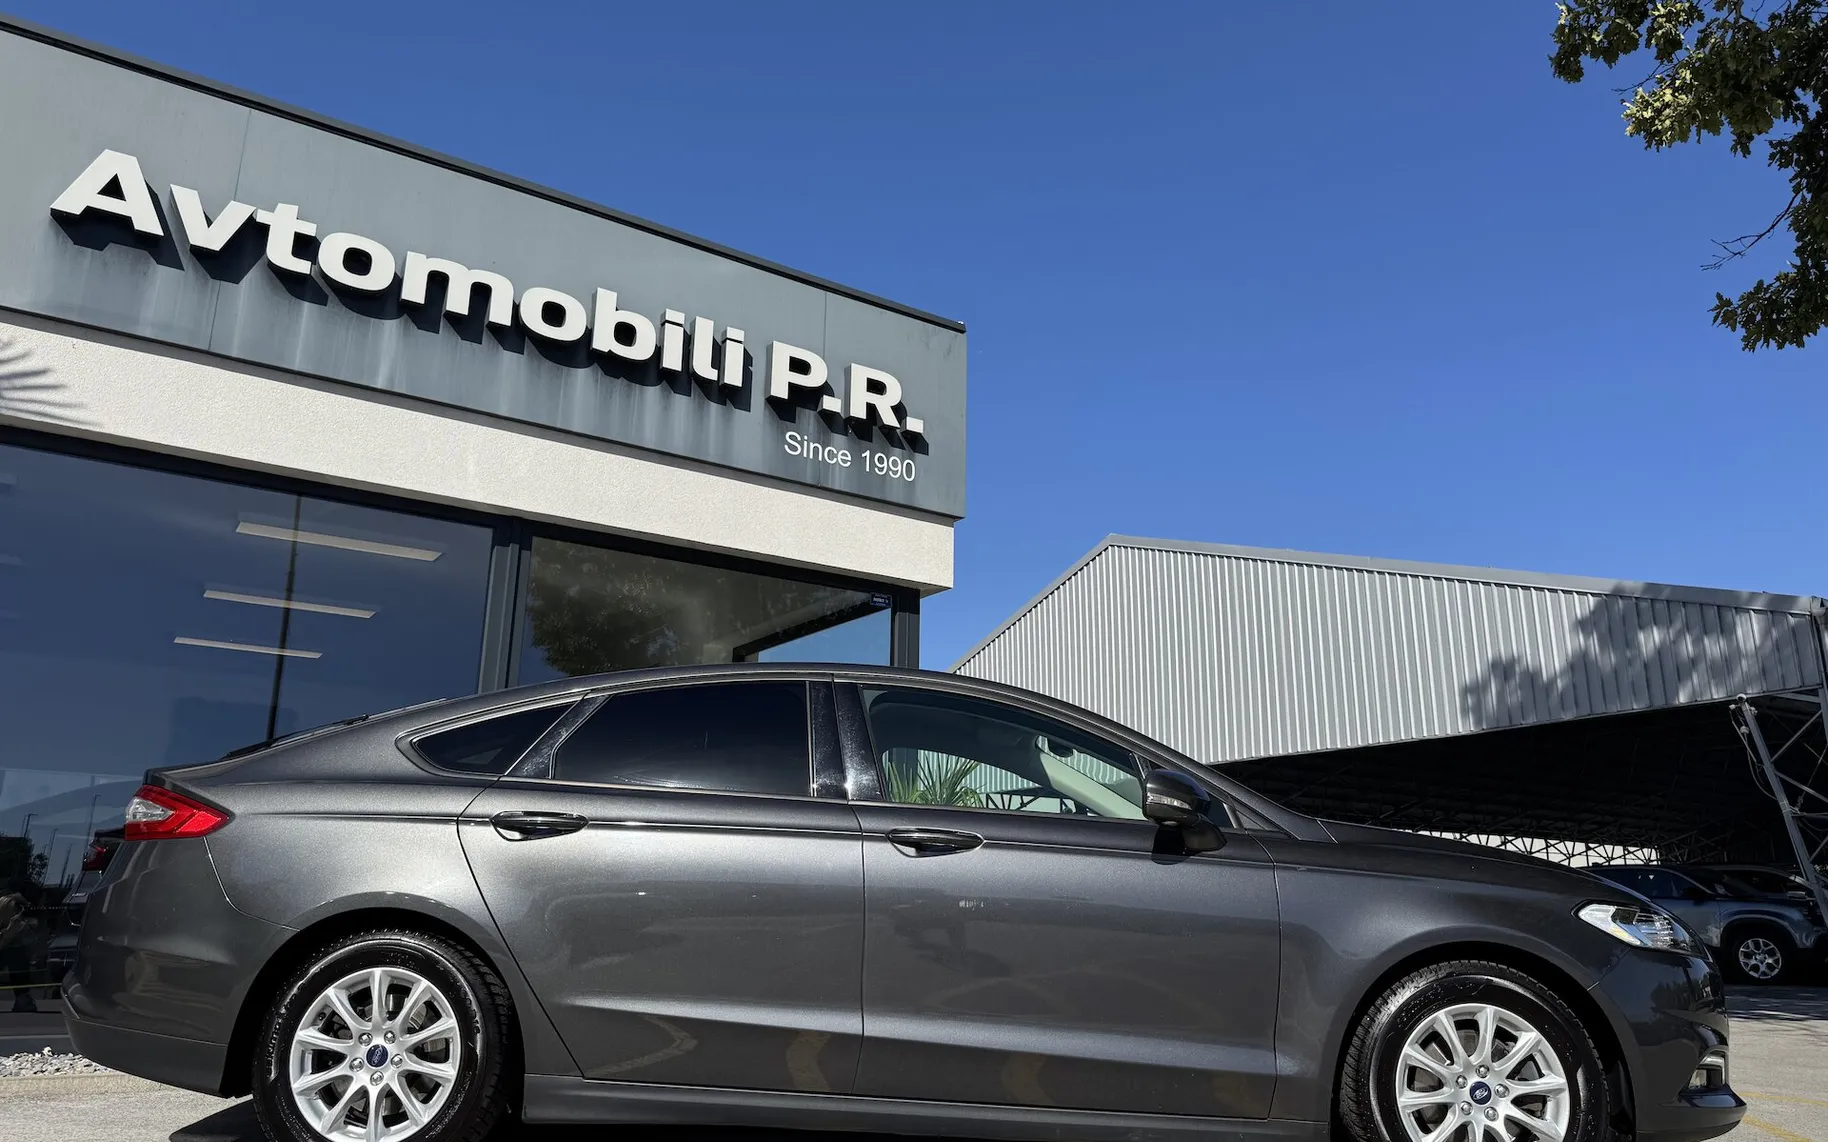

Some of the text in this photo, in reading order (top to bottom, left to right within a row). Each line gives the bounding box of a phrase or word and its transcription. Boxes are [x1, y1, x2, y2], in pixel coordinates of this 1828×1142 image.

[50, 149, 924, 434] Avtomobili P.R.
[784, 431, 916, 482] Since 1990
